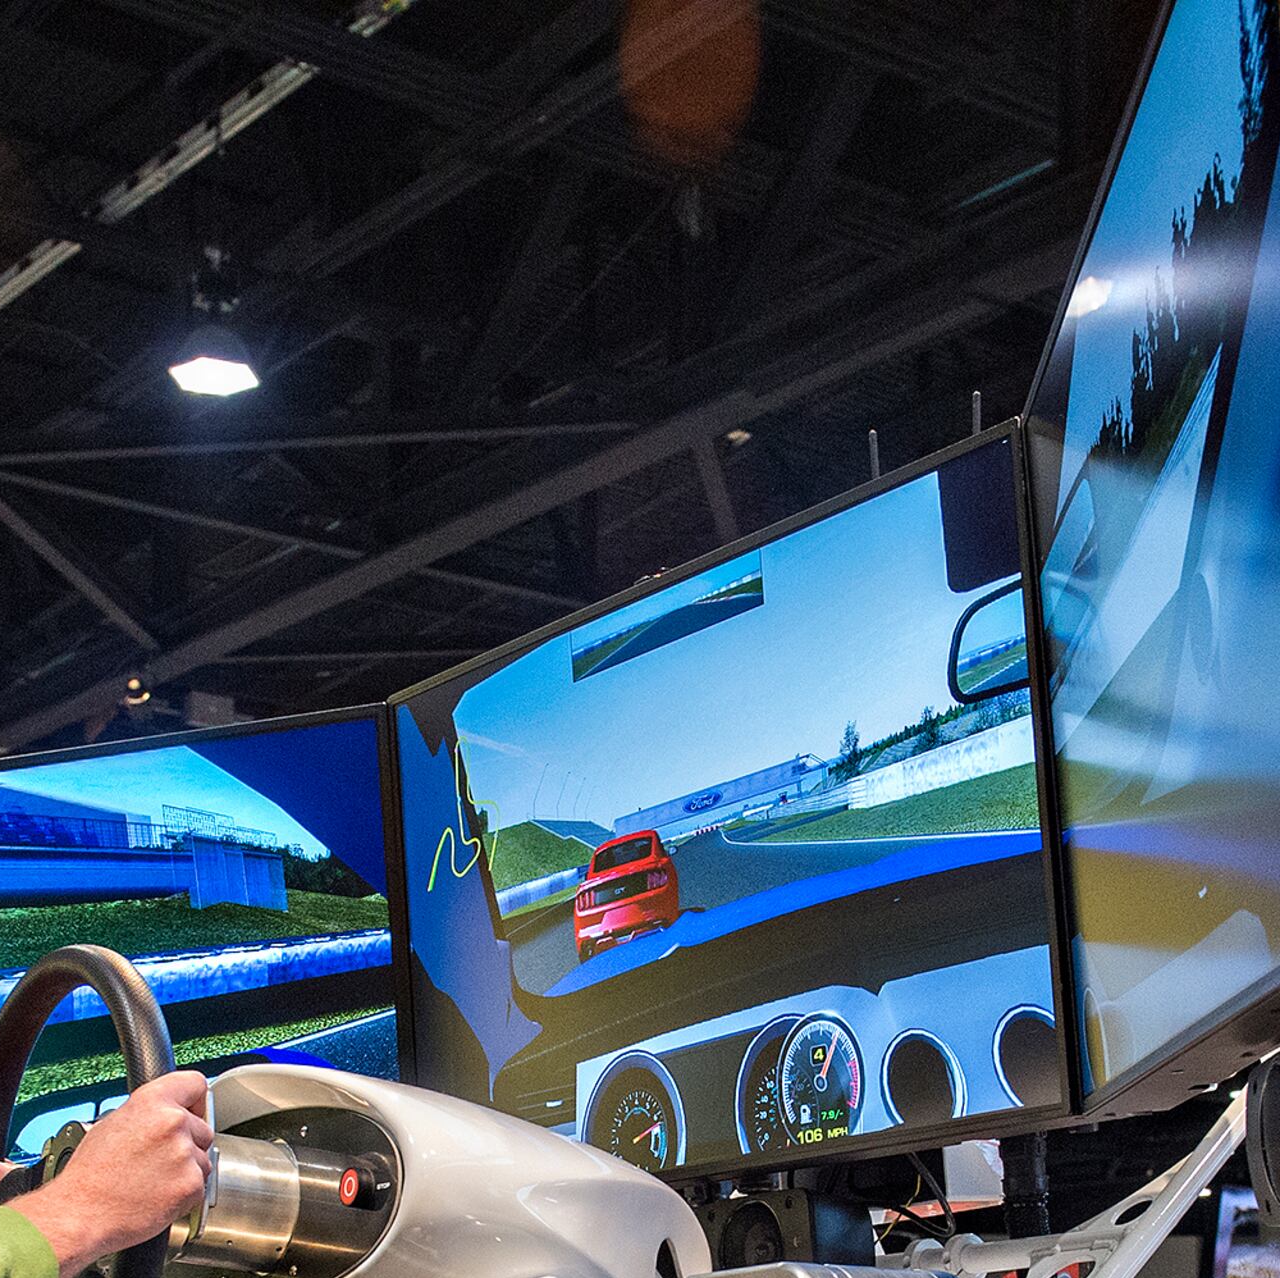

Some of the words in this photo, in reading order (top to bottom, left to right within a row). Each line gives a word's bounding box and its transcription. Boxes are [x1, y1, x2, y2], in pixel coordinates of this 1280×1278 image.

[813, 1048, 824, 1061] 4
[797, 1128, 823, 1145] 106
[827, 1127, 849, 1139] MPH
